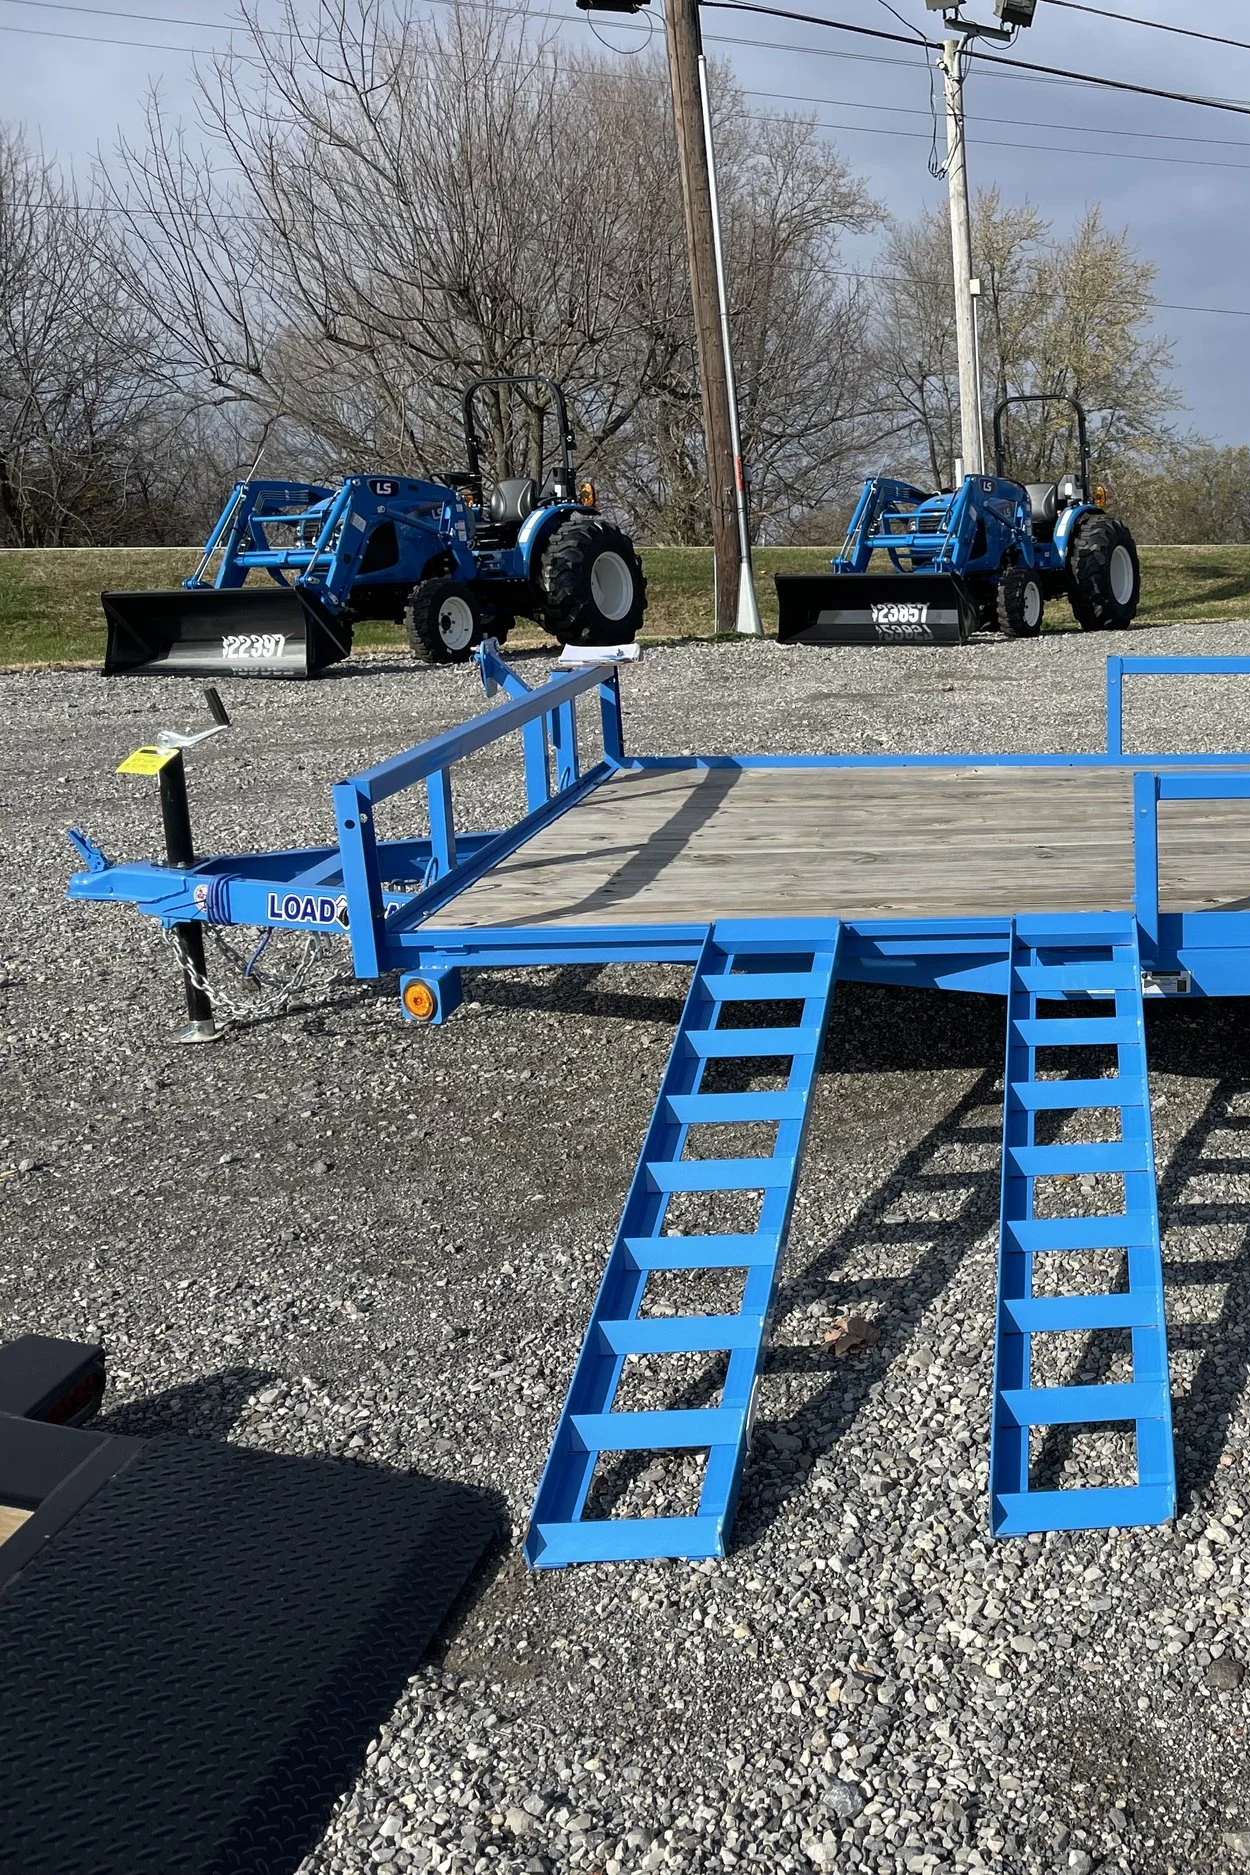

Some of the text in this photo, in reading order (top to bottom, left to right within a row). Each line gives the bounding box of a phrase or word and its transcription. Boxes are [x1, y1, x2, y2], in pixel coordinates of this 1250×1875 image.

[376, 482, 392, 495] LS
[983, 481, 992, 492] LS
[870, 603, 929, 623] $23857
[221, 633, 286, 659] $22397
[268, 893, 335, 924] LOAD
